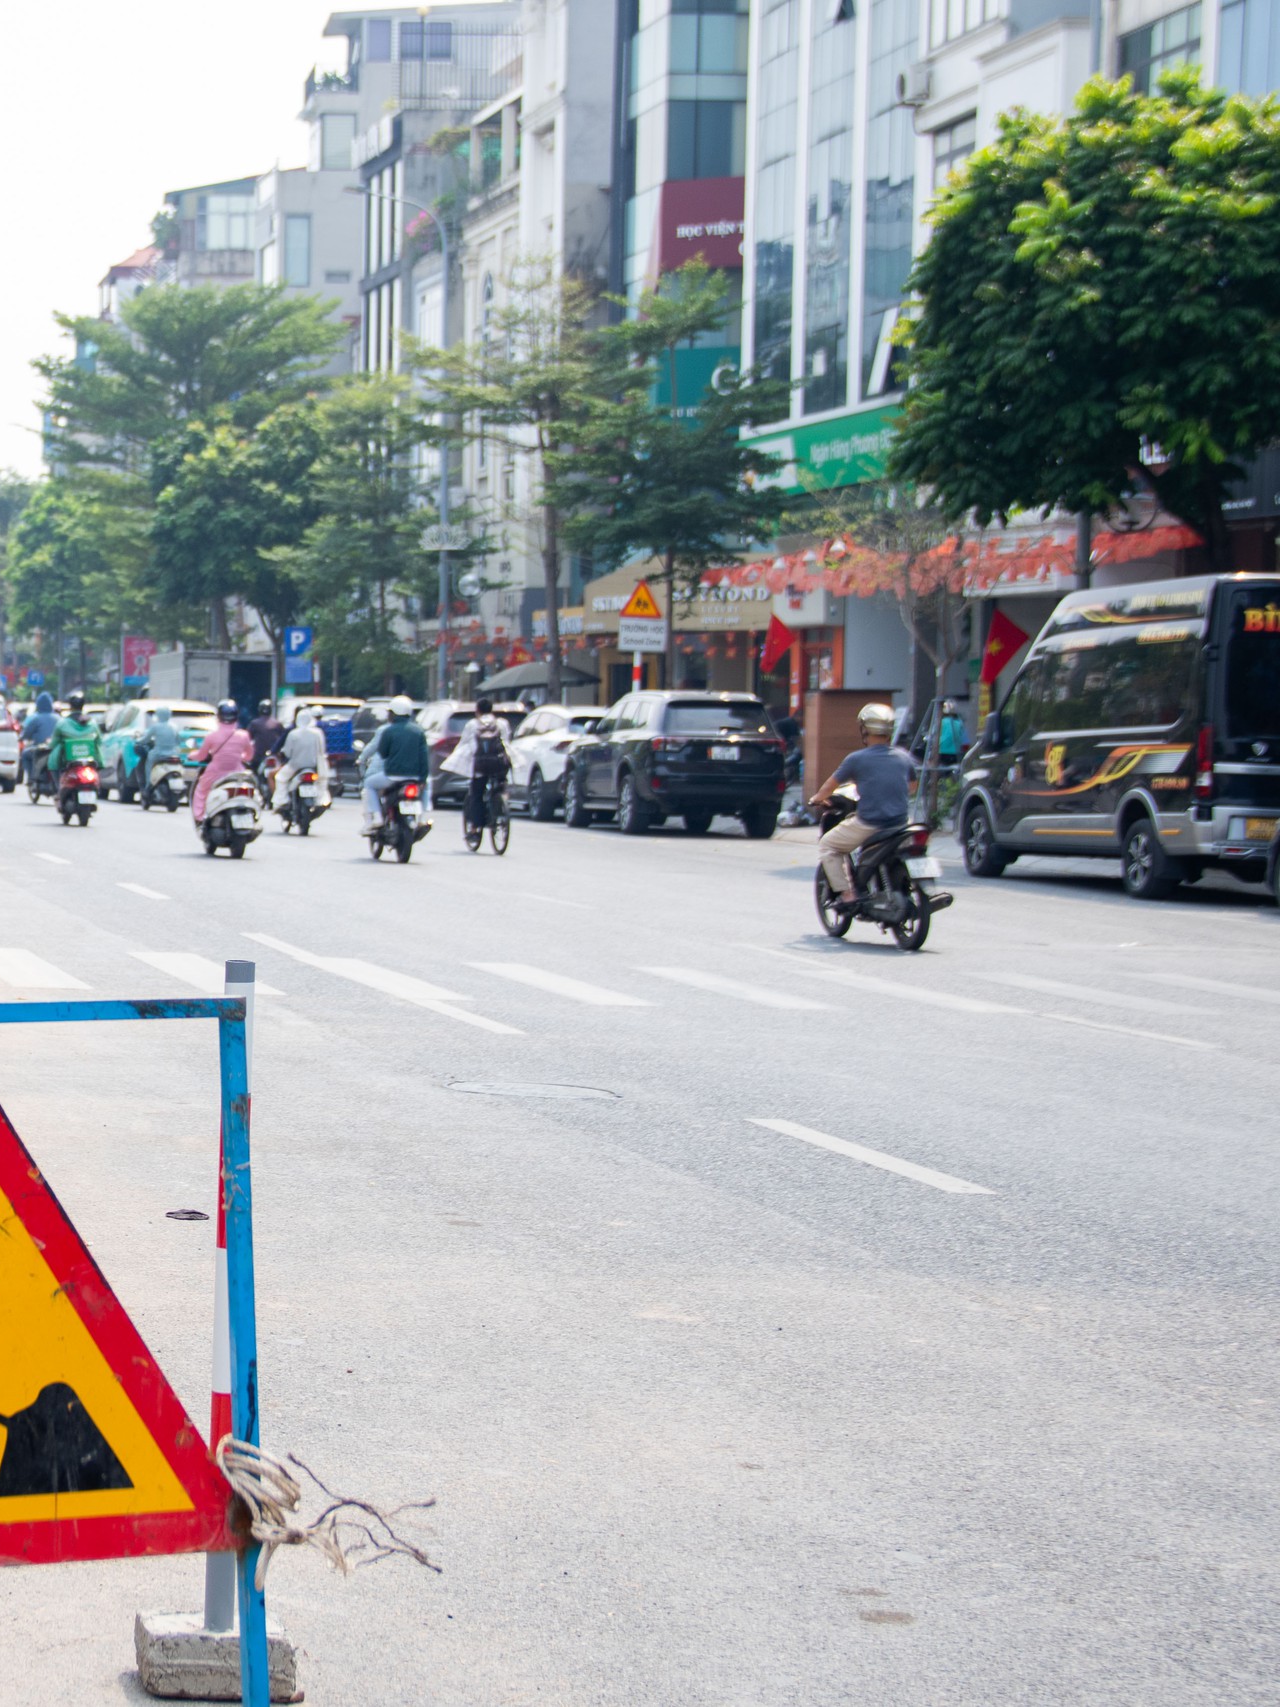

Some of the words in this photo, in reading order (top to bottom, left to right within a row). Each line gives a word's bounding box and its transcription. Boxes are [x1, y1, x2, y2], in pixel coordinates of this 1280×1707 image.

[676, 223, 703, 240] HỌC
[705, 218, 736, 238] VIỆN
[1243, 603, 1280, 632] BÌ
[291, 631, 305, 651] P
[623, 637, 644, 645] School
[646, 637, 661, 645] Zone
